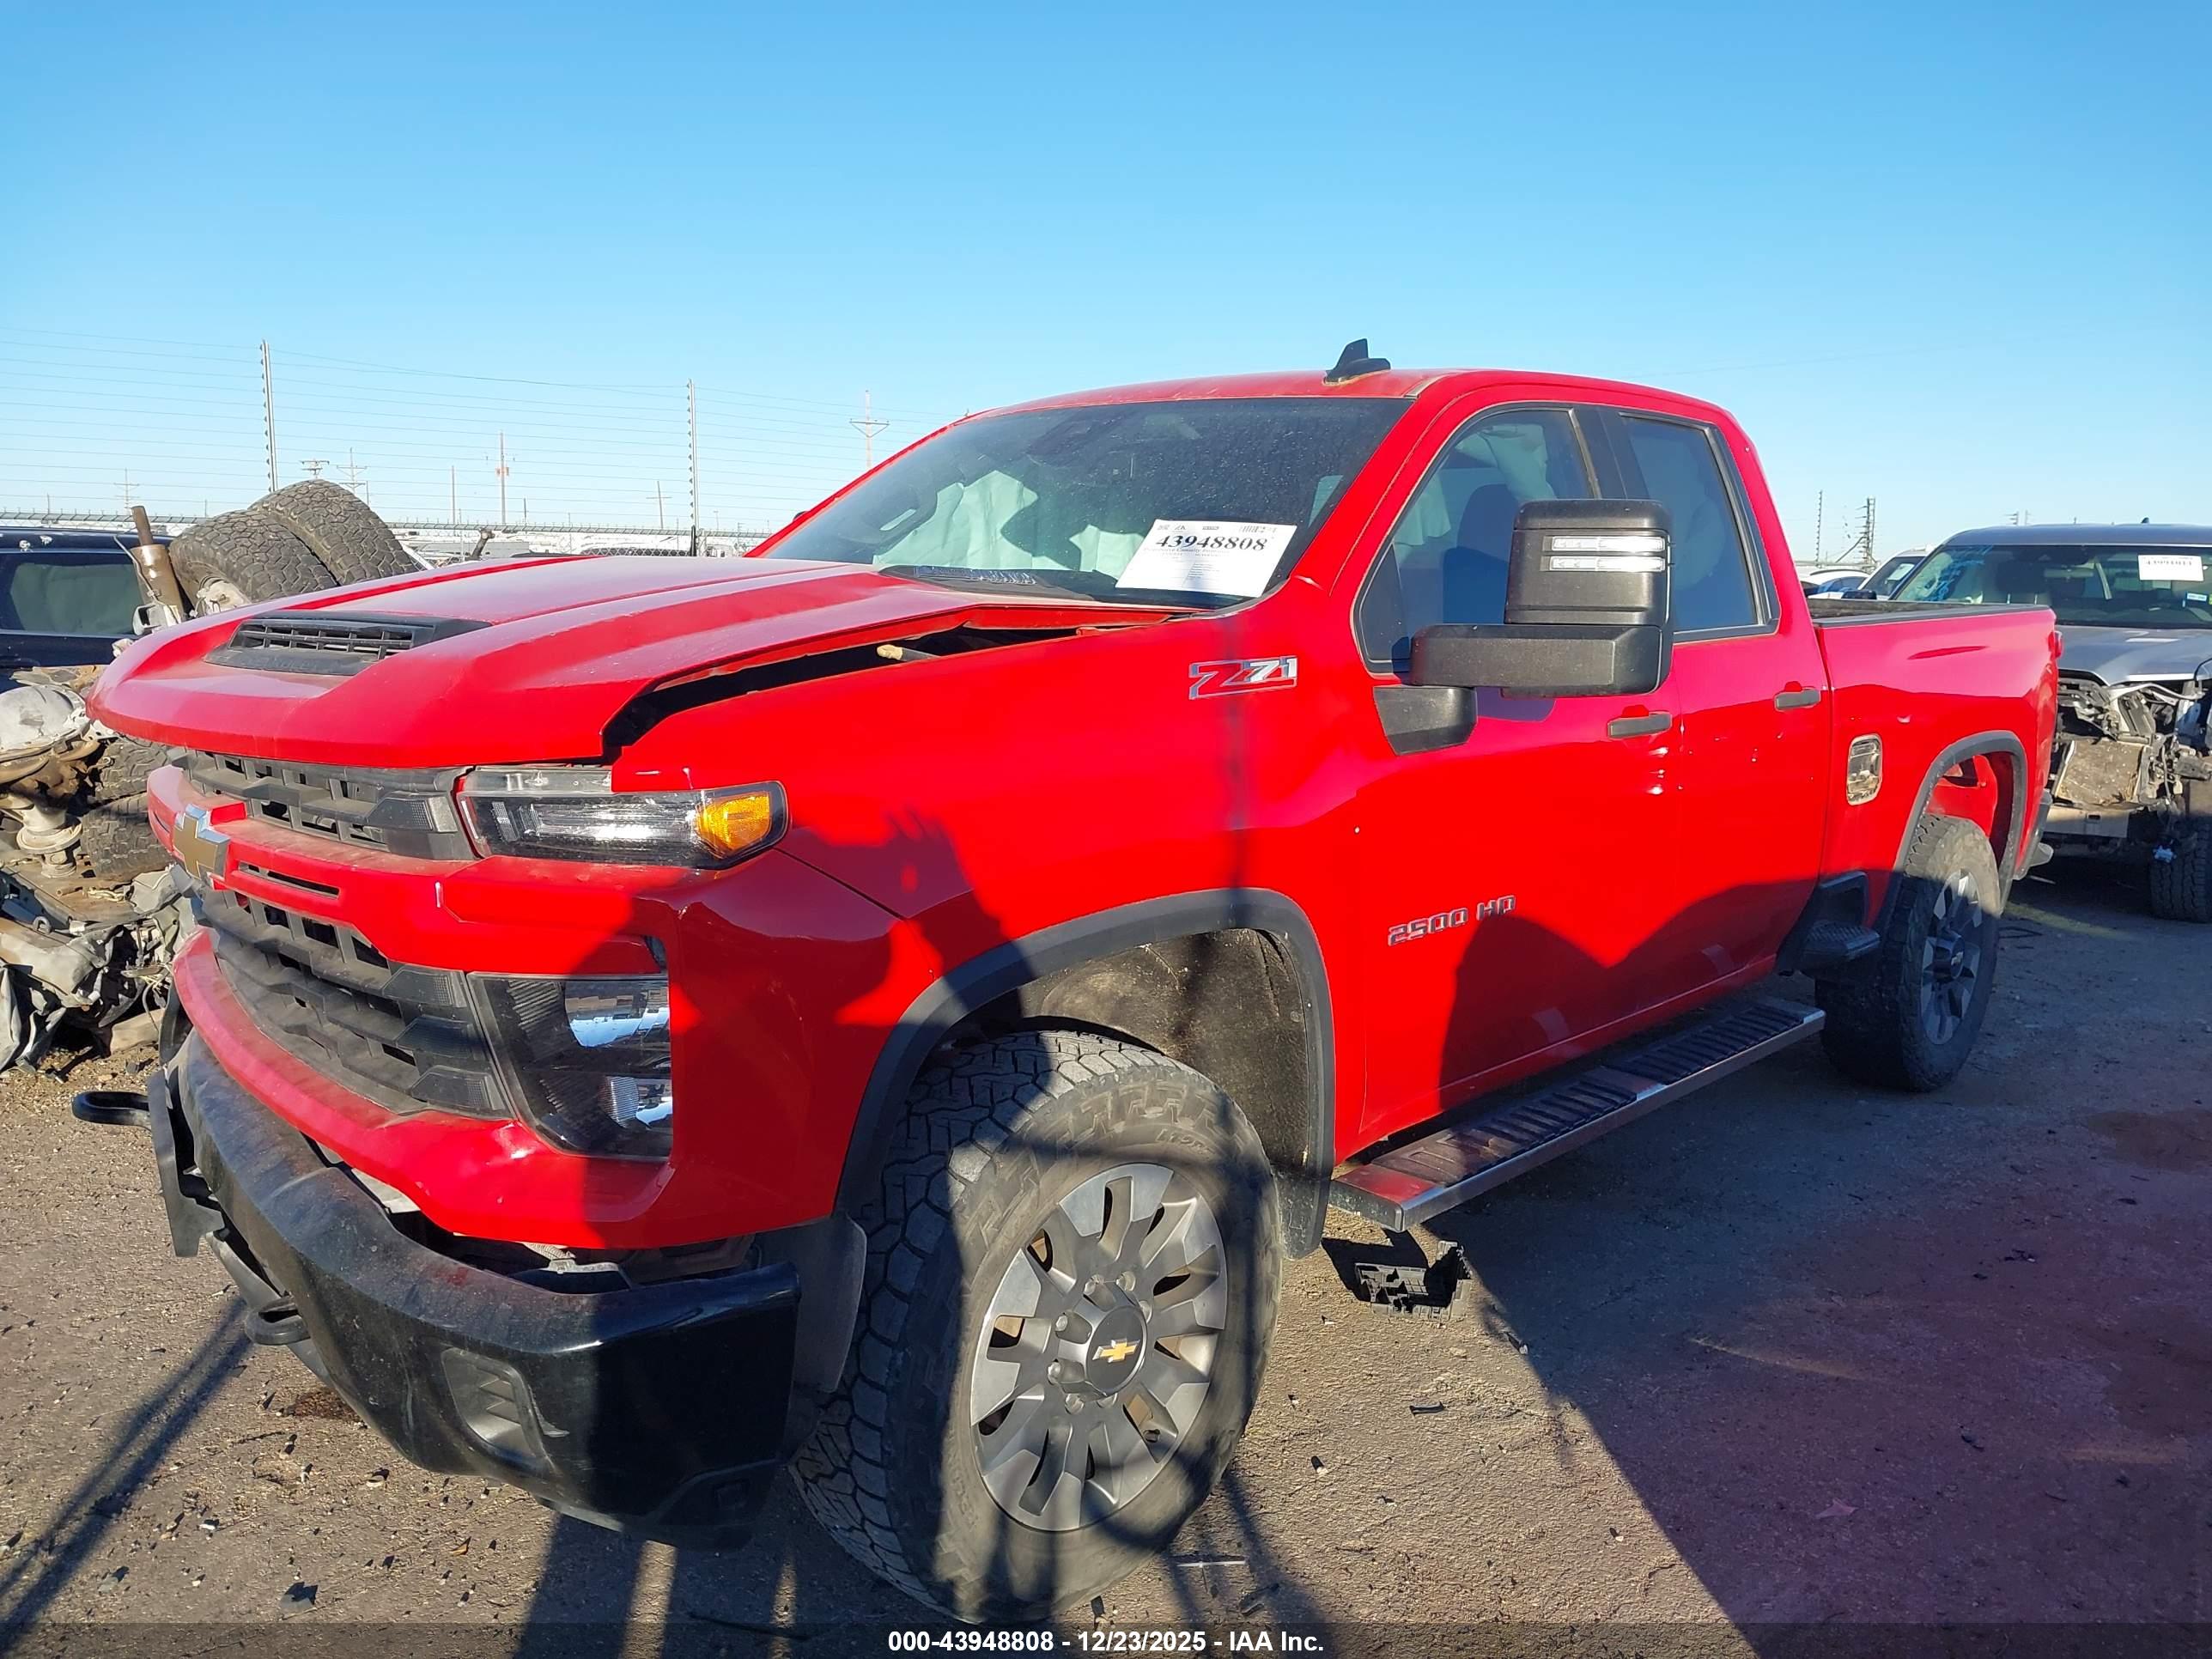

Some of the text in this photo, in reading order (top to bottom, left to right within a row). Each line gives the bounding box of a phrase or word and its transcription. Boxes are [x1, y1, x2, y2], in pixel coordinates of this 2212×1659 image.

[1156, 535, 1267, 550] 43948808
[1189, 655, 1297, 700] Z71
[1388, 895, 1516, 946] 2500 HD
